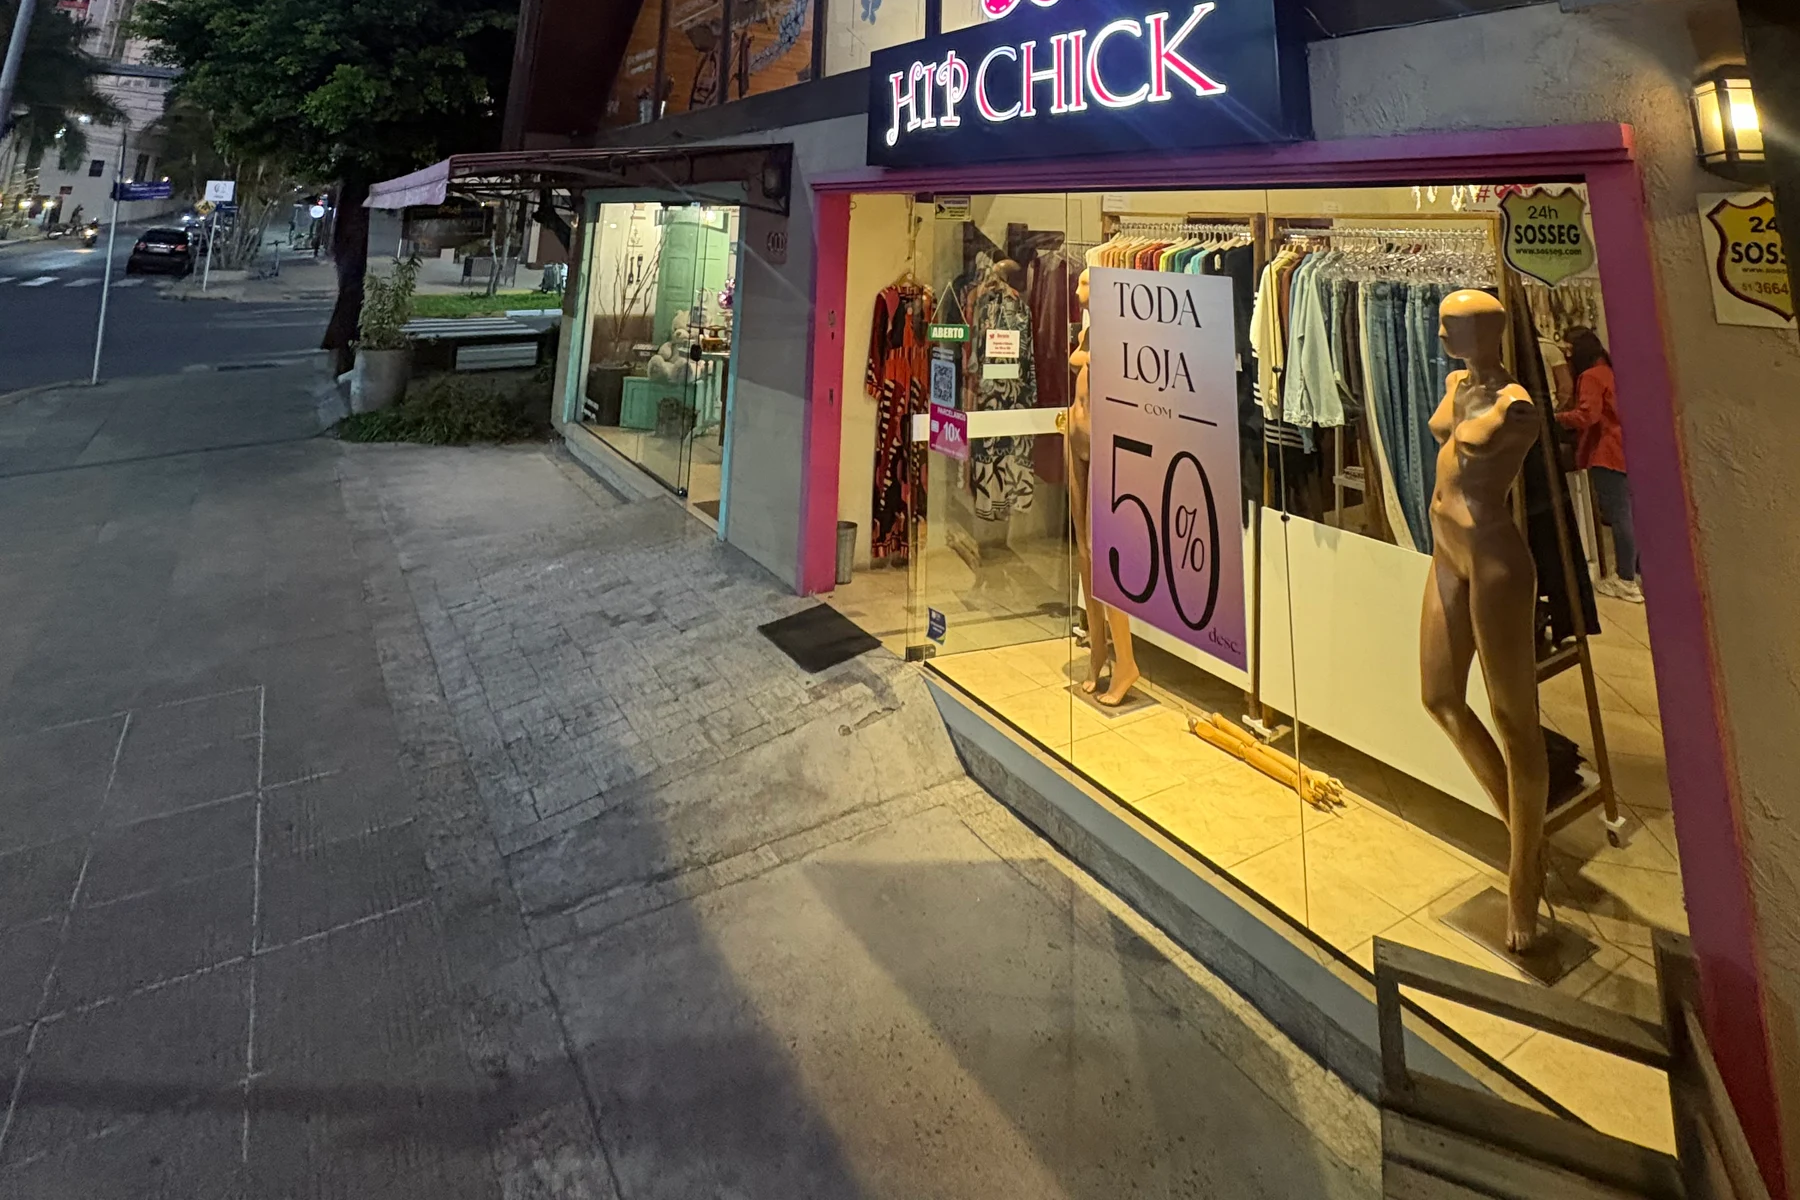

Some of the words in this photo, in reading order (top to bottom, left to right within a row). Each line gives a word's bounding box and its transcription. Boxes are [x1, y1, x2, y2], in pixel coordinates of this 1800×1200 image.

[886, 51, 969, 146] HIP
[976, 2, 1227, 122] CHICK
[1527, 205, 1559, 220] 24h
[1748, 216, 1778, 233] 24
[1514, 224, 1580, 245] SOSSEG
[1515, 248, 1582, 256] www.sosseg.com
[1731, 242, 1787, 265] SOS
[1113, 281, 1202, 328] TODA
[932, 327, 964, 339] ABERTO
[1122, 342, 1196, 393] LOJA
[1144, 403, 1172, 419] COM
